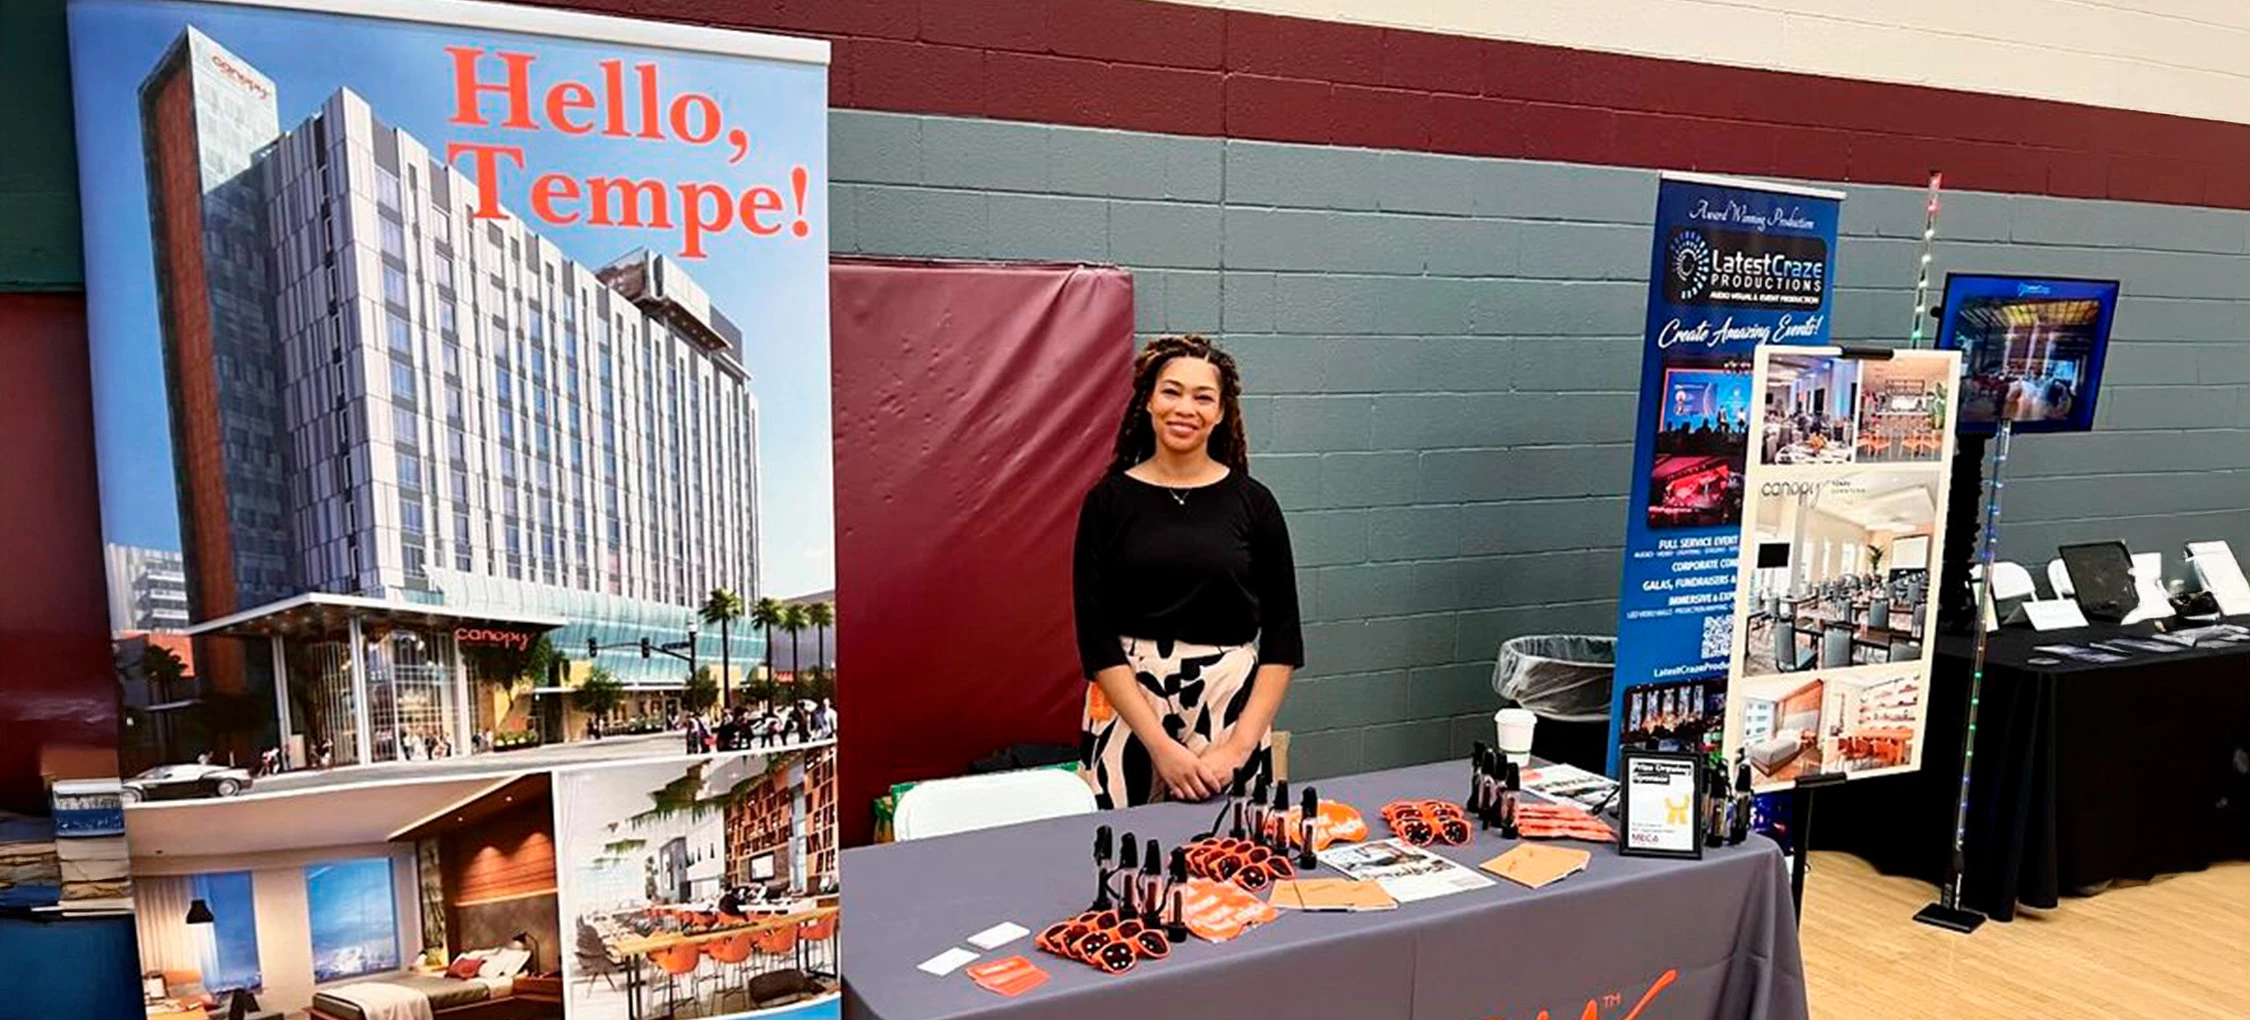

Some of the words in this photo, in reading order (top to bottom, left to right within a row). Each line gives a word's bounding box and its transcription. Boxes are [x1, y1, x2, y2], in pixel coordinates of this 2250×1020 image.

[444, 44, 749, 164] Hello,
[445, 140, 810, 259] Tempe!
[1689, 200, 1728, 221] Award
[1728, 200, 1766, 232] Winning
[1767, 207, 1815, 230] Production
[1712, 250, 1823, 279] LatestCraze
[1710, 274, 1822, 292] PRODUCTIONS
[1658, 318, 1709, 348] Create
[1707, 316, 1770, 347] Amazing
[1772, 313, 1824, 343] Events!
[1761, 482, 1821, 509] canopy
[1659, 539, 1678, 550] FULL
[1680, 537, 1712, 548] SERVICE
[1714, 535, 1739, 546] EVENT
[1671, 559, 1718, 572] CORPORATE
[1720, 558, 1739, 569] CON
[1642, 579, 1674, 591] GALAS,
[1675, 575, 1729, 588] FUNDRAISERS
[455, 627, 529, 652] canopy
